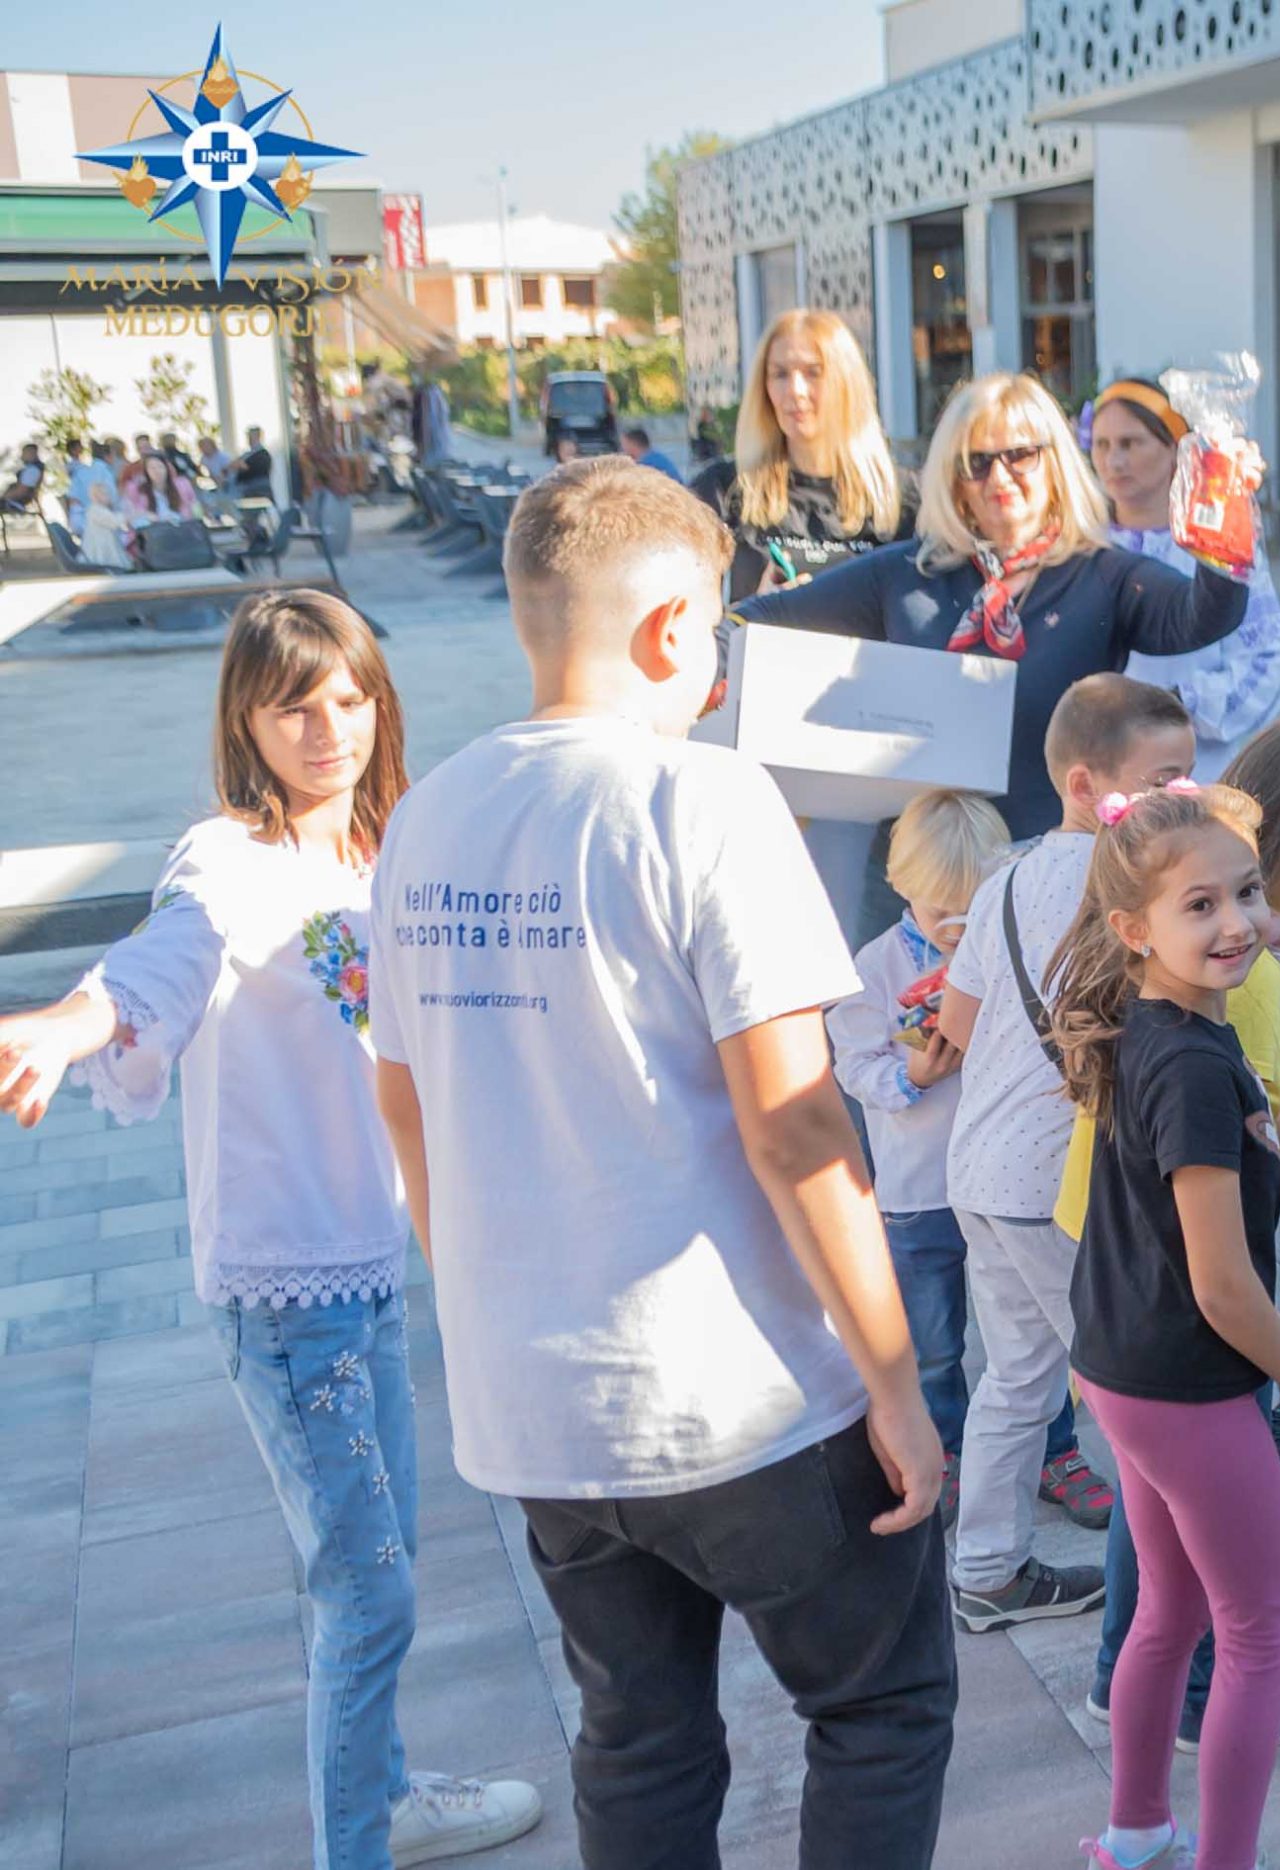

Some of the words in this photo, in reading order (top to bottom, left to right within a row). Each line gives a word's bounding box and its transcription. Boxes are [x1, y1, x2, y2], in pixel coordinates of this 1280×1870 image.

[528, 882, 562, 914] ciò
[497, 918, 510, 949] è
[518, 922, 587, 949] mare
